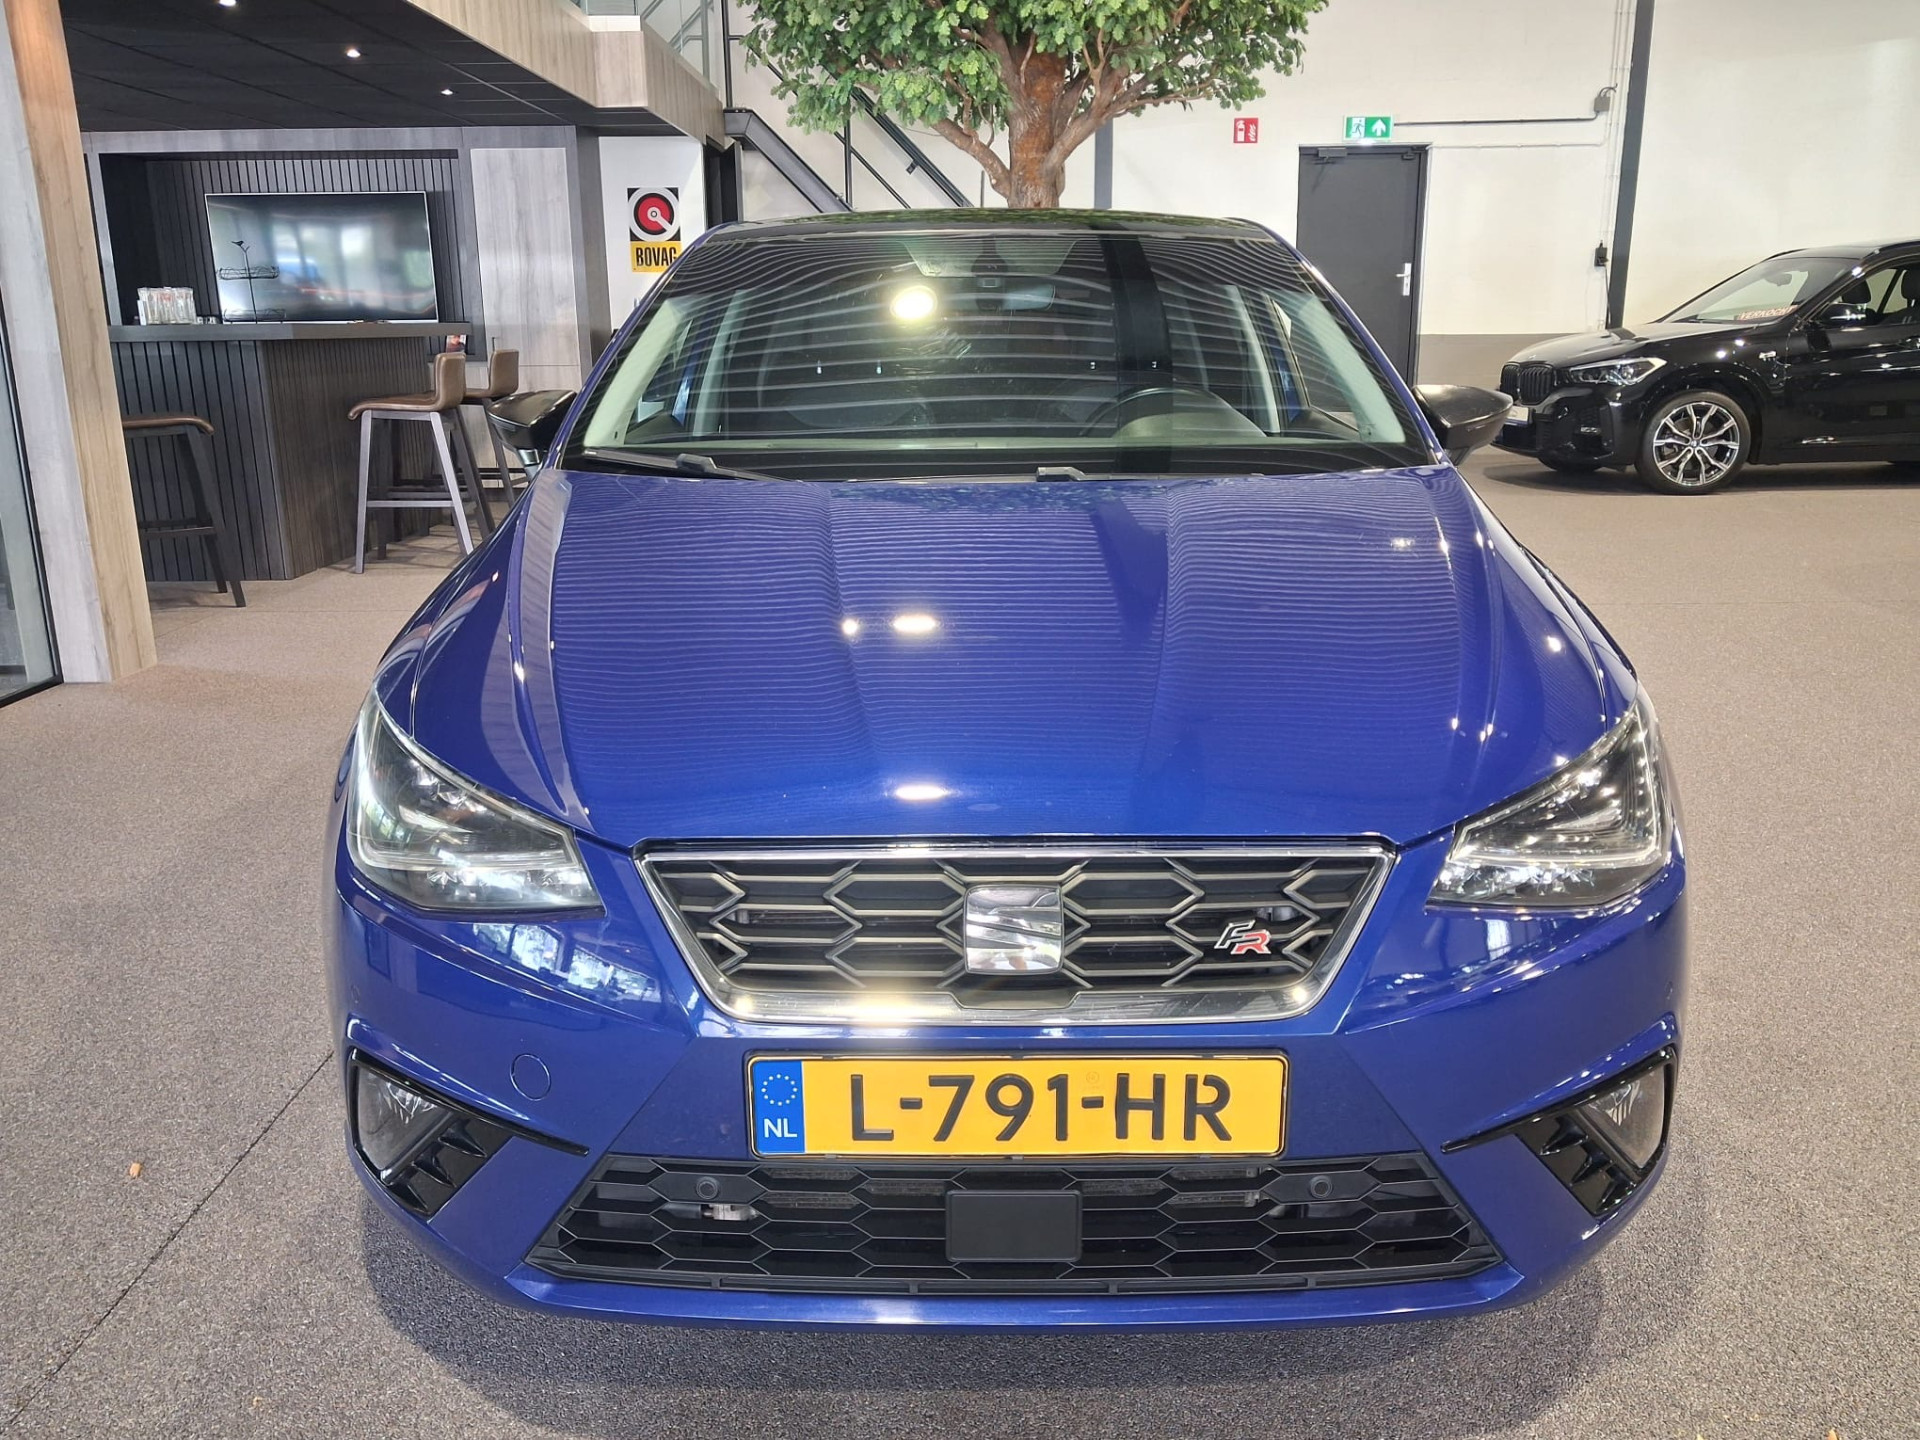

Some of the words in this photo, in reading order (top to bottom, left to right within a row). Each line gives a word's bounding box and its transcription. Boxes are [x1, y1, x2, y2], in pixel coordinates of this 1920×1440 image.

[1213, 919, 1272, 955] FR
[850, 1073, 1232, 1142] L-791-HR
[763, 1117, 798, 1138] NL
